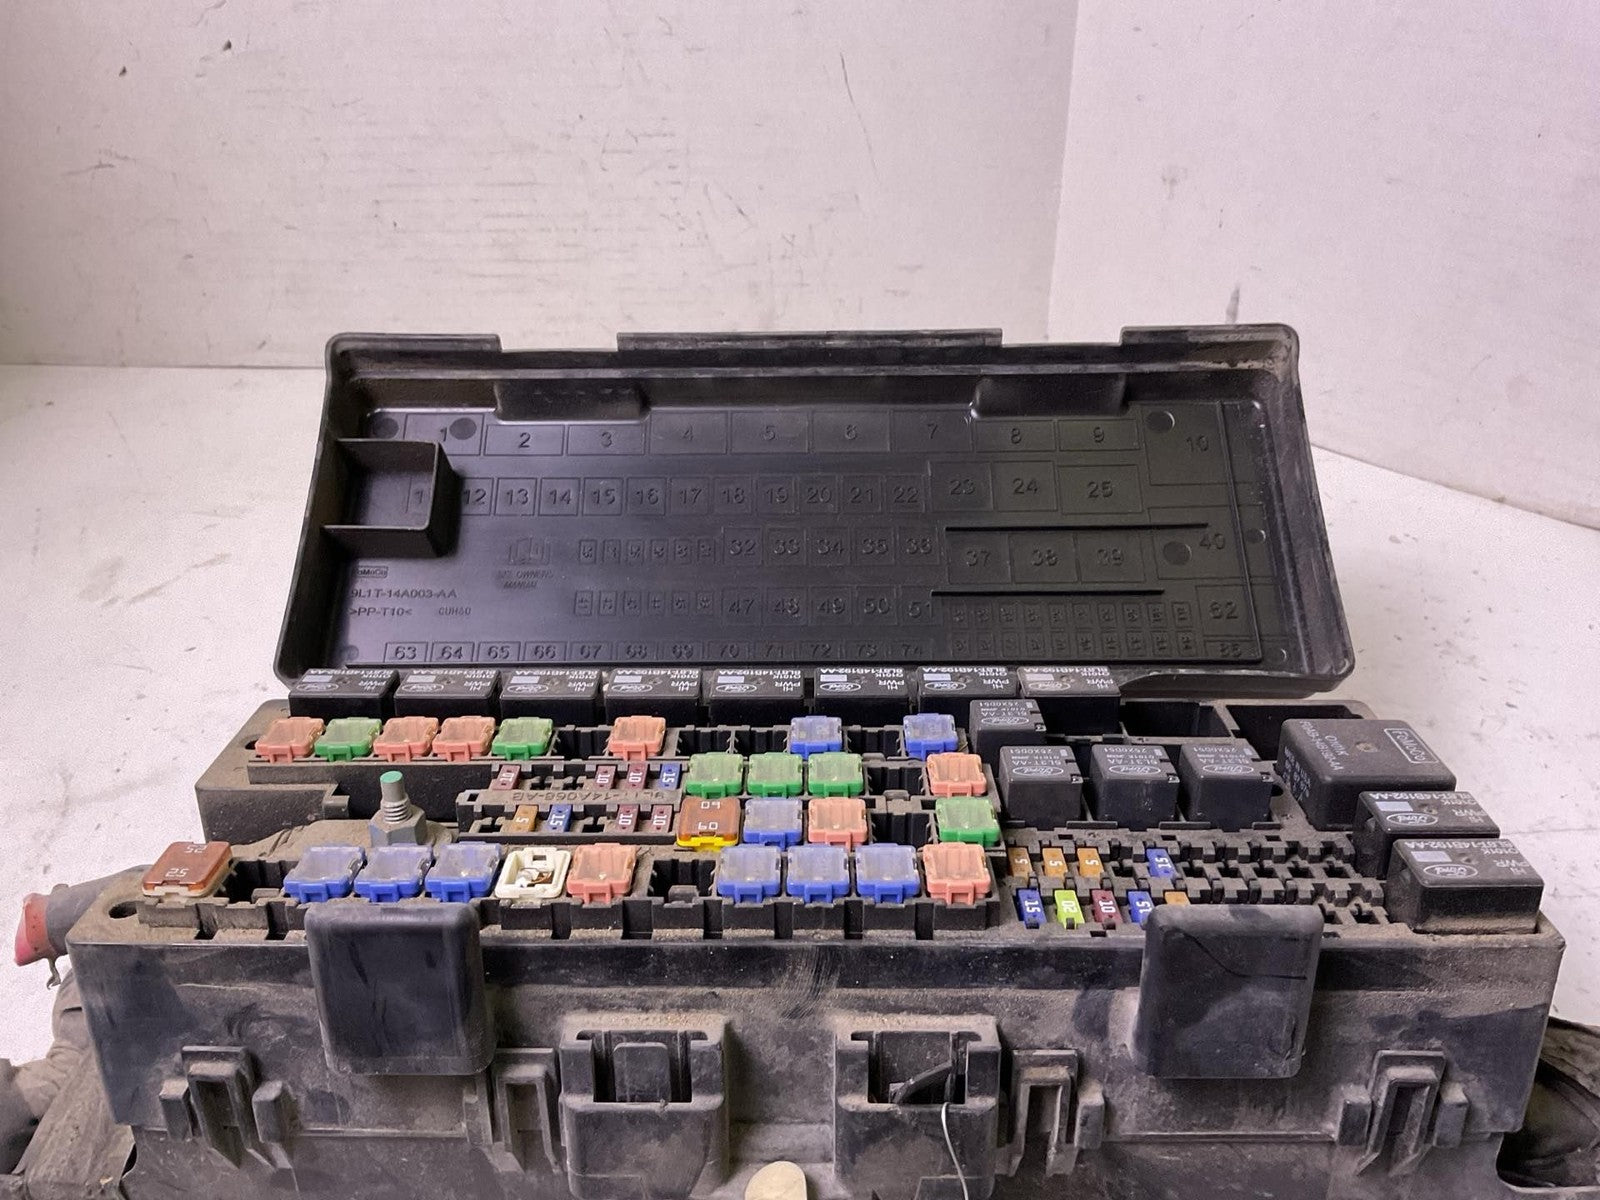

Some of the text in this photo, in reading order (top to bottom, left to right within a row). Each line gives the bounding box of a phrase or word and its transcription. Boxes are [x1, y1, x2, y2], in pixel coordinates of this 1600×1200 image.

[440, 427, 448, 442] 1
[601, 430, 613, 448] 3
[682, 425, 694, 441] 4
[764, 425, 777, 441] 5
[927, 423, 939, 440] 7
[1010, 427, 1022, 444] 8
[1092, 426, 1105, 443] 9
[518, 431, 532, 449] 2
[1185, 436, 1210, 452] 10
[807, 486, 832, 503] 20
[850, 486, 874, 503] 21
[949, 479, 975, 496] 23
[1012, 478, 1038, 495] 24
[1087, 480, 1114, 499] 25
[463, 488, 486, 505] 12
[506, 489, 529, 505] 13
[549, 489, 571, 505] 14
[593, 489, 616, 504] 15
[636, 488, 659, 504] 16
[680, 488, 702, 503] 17
[723, 487, 745, 503] 18
[766, 487, 789, 503] 19
[893, 487, 919, 504] 22
[729, 538, 757, 555] 32
[817, 538, 843, 555] 34
[861, 538, 888, 554] 35
[1199, 533, 1226, 550] 40
[966, 550, 991, 567] 37
[1097, 549, 1124, 566] 39
[728, 600, 755, 615] 47
[817, 598, 846, 614] 49
[863, 598, 890, 614] 50
[908, 601, 933, 619] 51
[394, 646, 417, 660] 63
[441, 646, 463, 660] 64
[487, 645, 510, 660] 65
[533, 645, 556, 659] 66
[580, 645, 602, 659] 67
[764, 643, 785, 658] 71
[810, 643, 833, 658] 72
[856, 643, 879, 658] 73
[500, 772, 514, 782] 10
[596, 774, 609, 784] 10
[629, 772, 642, 783] 10
[662, 772, 675, 783] 15
[550, 814, 566, 826] 15
[619, 814, 633, 825] 10
[653, 814, 668, 826] 10
[1393, 814, 1431, 825] Ford
[1155, 857, 1172, 868] 15
[165, 868, 190, 877] 25
[1431, 865, 1469, 877] Ford
[1024, 900, 1039, 913] 15
[1061, 900, 1078, 913] 20
[1098, 900, 1116, 913] 10
[1136, 901, 1152, 914] 15
